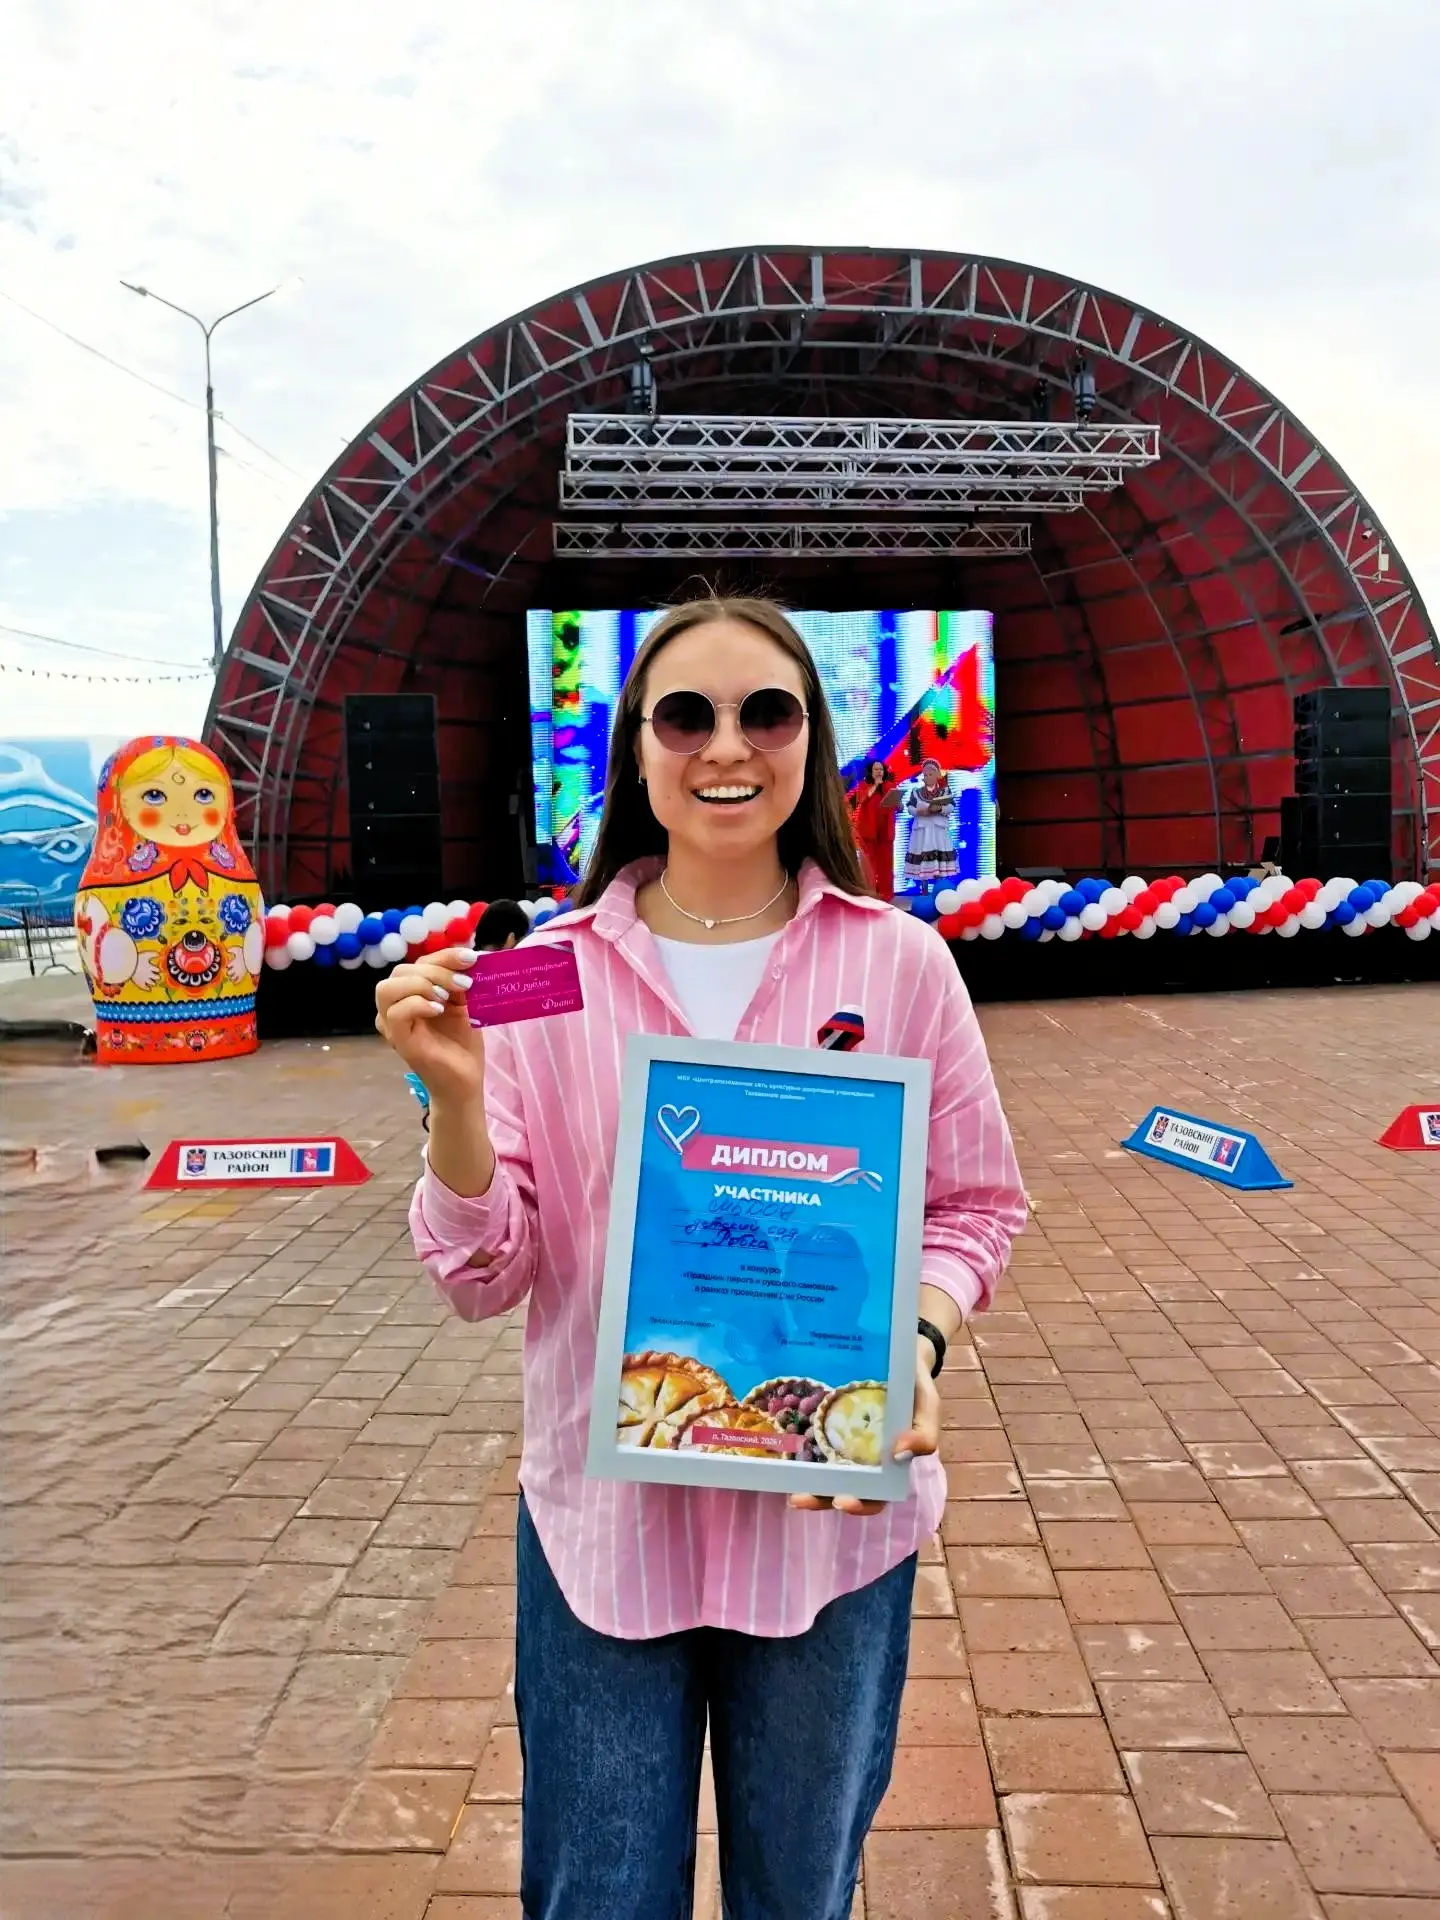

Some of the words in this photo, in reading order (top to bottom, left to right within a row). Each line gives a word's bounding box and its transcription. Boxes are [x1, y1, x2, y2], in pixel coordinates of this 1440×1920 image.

[496, 982, 520, 995] 1500
[711, 1144, 829, 1173] ДИПЛОМ
[713, 1183, 822, 1207] УЧАСТНИКА
